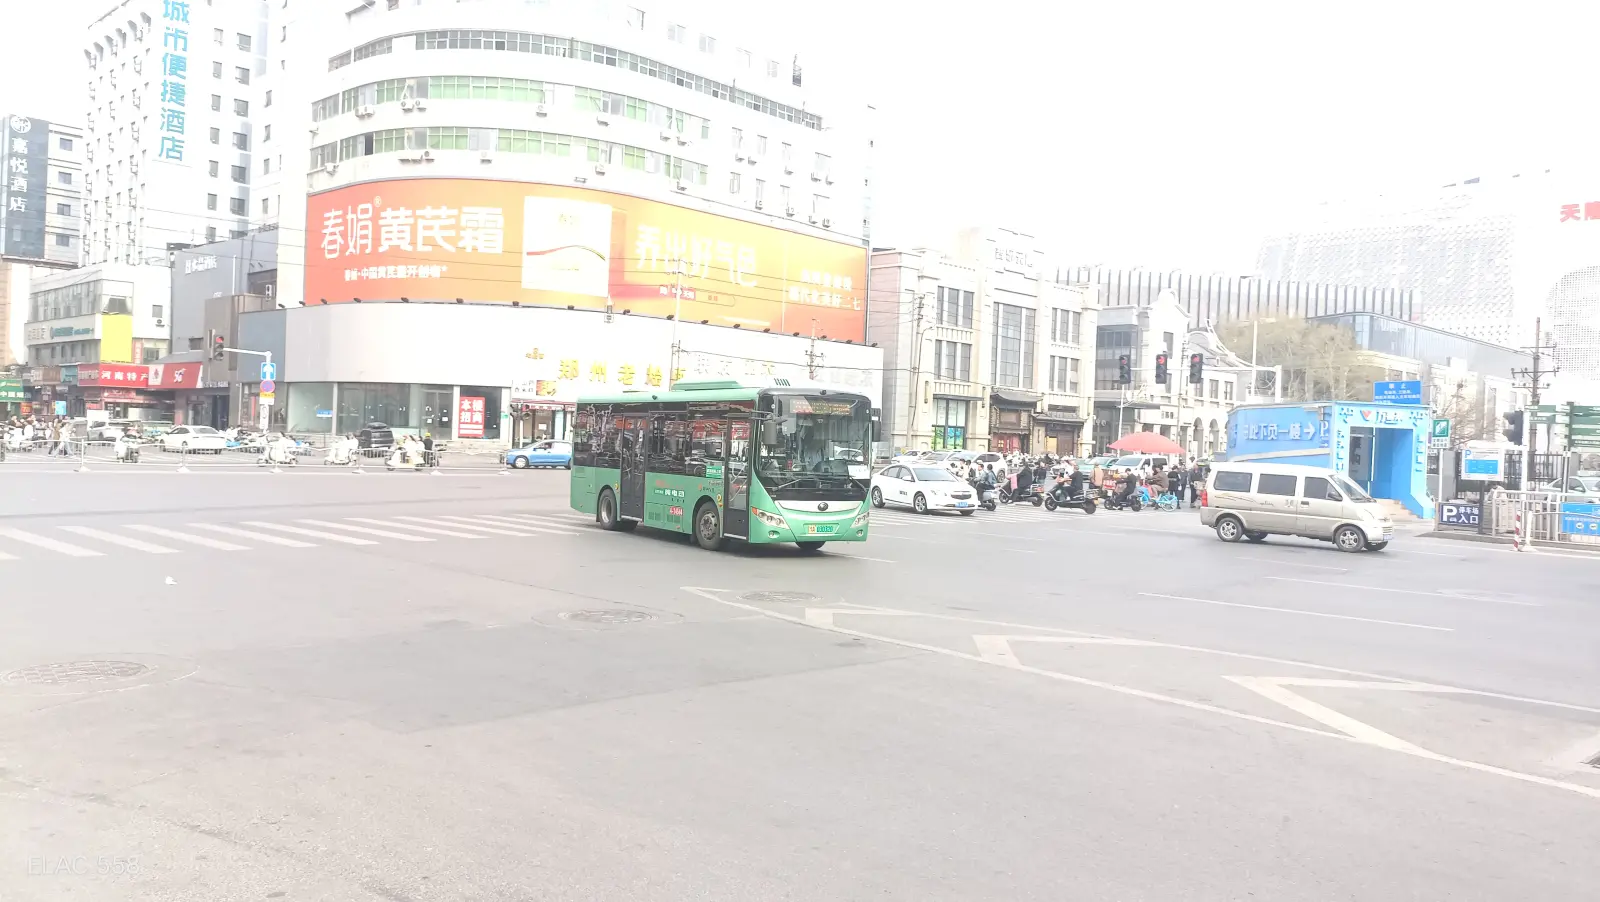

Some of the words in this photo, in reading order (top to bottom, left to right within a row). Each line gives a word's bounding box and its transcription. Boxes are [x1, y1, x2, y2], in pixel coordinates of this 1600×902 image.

[159, 0, 190, 161] 城市便捷酒店
[9, 137, 29, 212] 嘉悦酒店
[1442, 505, 1458, 521] P
[1458, 506, 1479, 515] 停车场
[1458, 514, 1479, 524] 入口
